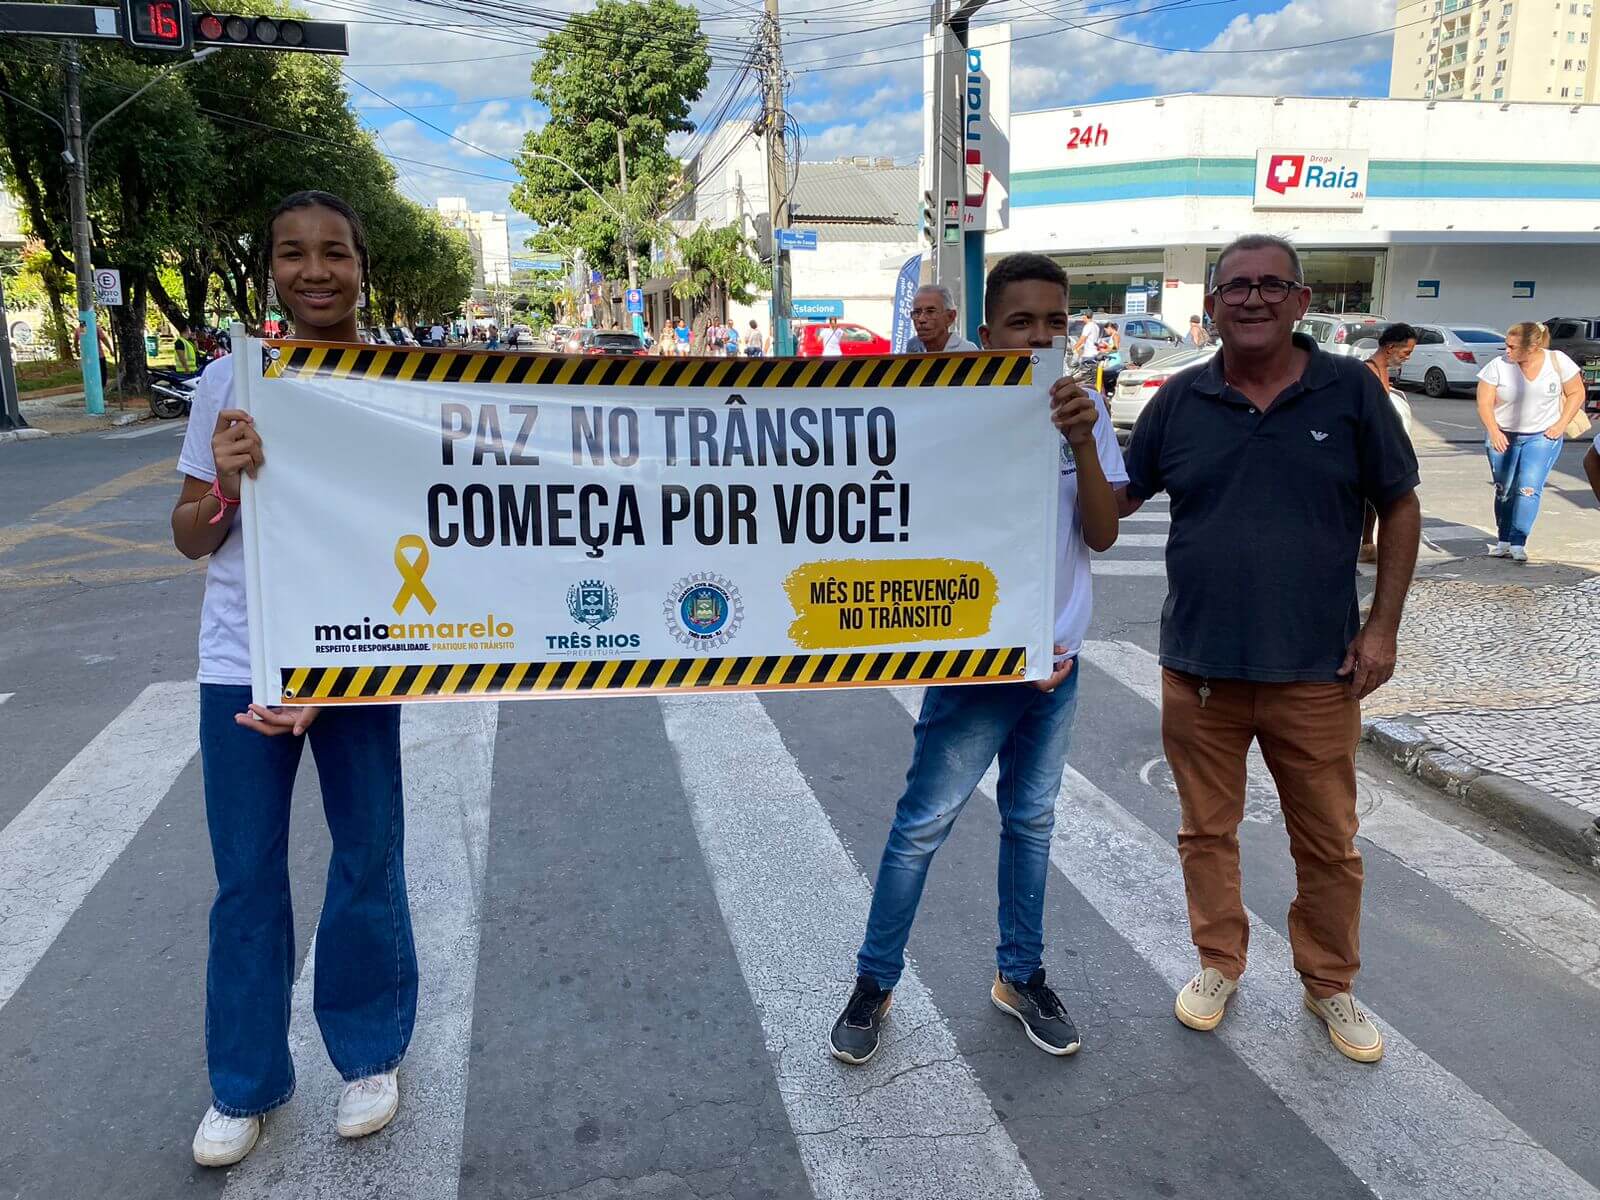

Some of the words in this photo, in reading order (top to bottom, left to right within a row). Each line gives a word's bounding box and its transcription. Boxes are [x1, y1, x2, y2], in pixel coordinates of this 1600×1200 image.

[147, 2, 177, 38] 16
[1066, 122, 1109, 149] 24h
[1310, 155, 1333, 164] Droga
[1305, 165, 1359, 188] Raia
[1350, 191, 1364, 199] 24h
[103, 276, 111, 285] E
[793, 303, 836, 313] Estacione
[440, 403, 539, 466] PAZ
[571, 404, 639, 467] NO
[654, 394, 897, 467] TRÂNSITO
[427, 483, 646, 558] COMEÇA
[661, 484, 757, 546] POR
[773, 470, 910, 544] VOCÊ!
[810, 577, 848, 604] MÊS
[853, 581, 875, 603] DE
[880, 574, 980, 604] PREVENÇÃO
[839, 607, 863, 630] NO
[868, 603, 952, 629] TRÂNSITO
[315, 645, 350, 653] RESPEITO
[352, 645, 357, 653] E
[358, 643, 430, 652] RESPONSABILIDADE.
[432, 642, 467, 651] PRATIQUE
[469, 641, 479, 650] NO
[480, 639, 514, 650] TRÂNSITO
[545, 631, 592, 649] TRÊS
[596, 634, 640, 648] RIOS
[566, 648, 620, 657] PREFEITURA
